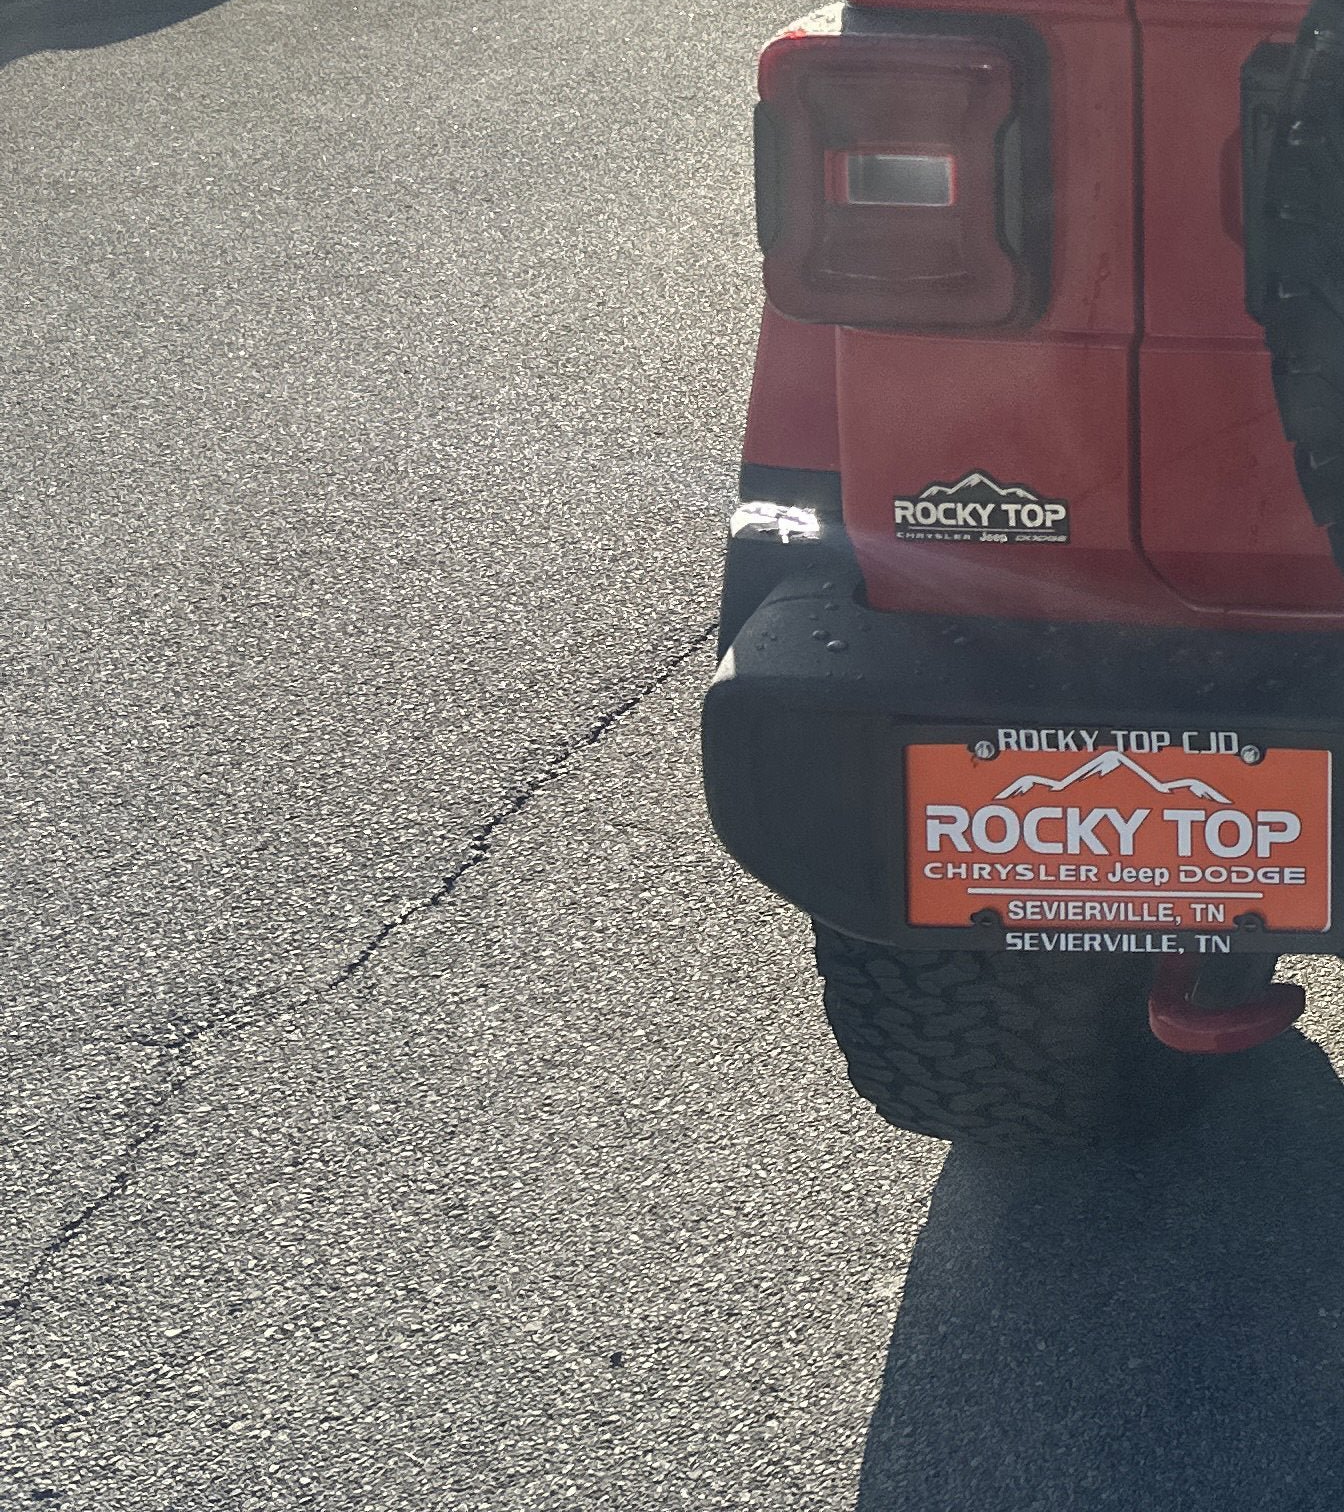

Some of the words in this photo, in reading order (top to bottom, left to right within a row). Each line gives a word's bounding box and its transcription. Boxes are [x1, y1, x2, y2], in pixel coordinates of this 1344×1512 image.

[894, 500, 995, 527] ROCKY
[1001, 503, 1067, 528] TOP
[997, 728, 1100, 753] ROCKY
[1111, 730, 1172, 754] TOP
[1183, 731, 1239, 756] CJD
[924, 804, 1152, 857] ROCKY
[1162, 809, 1302, 859] TOP
[924, 862, 1100, 882] CHRYSLER
[1107, 862, 1170, 886] Jeep
[1179, 865, 1306, 885] DODGE
[1008, 901, 1182, 926] SEVIERVILLE,
[1189, 902, 1226, 923] TN
[1005, 932, 1185, 955] SEVIERVILLE,
[1195, 934, 1231, 954] TN
